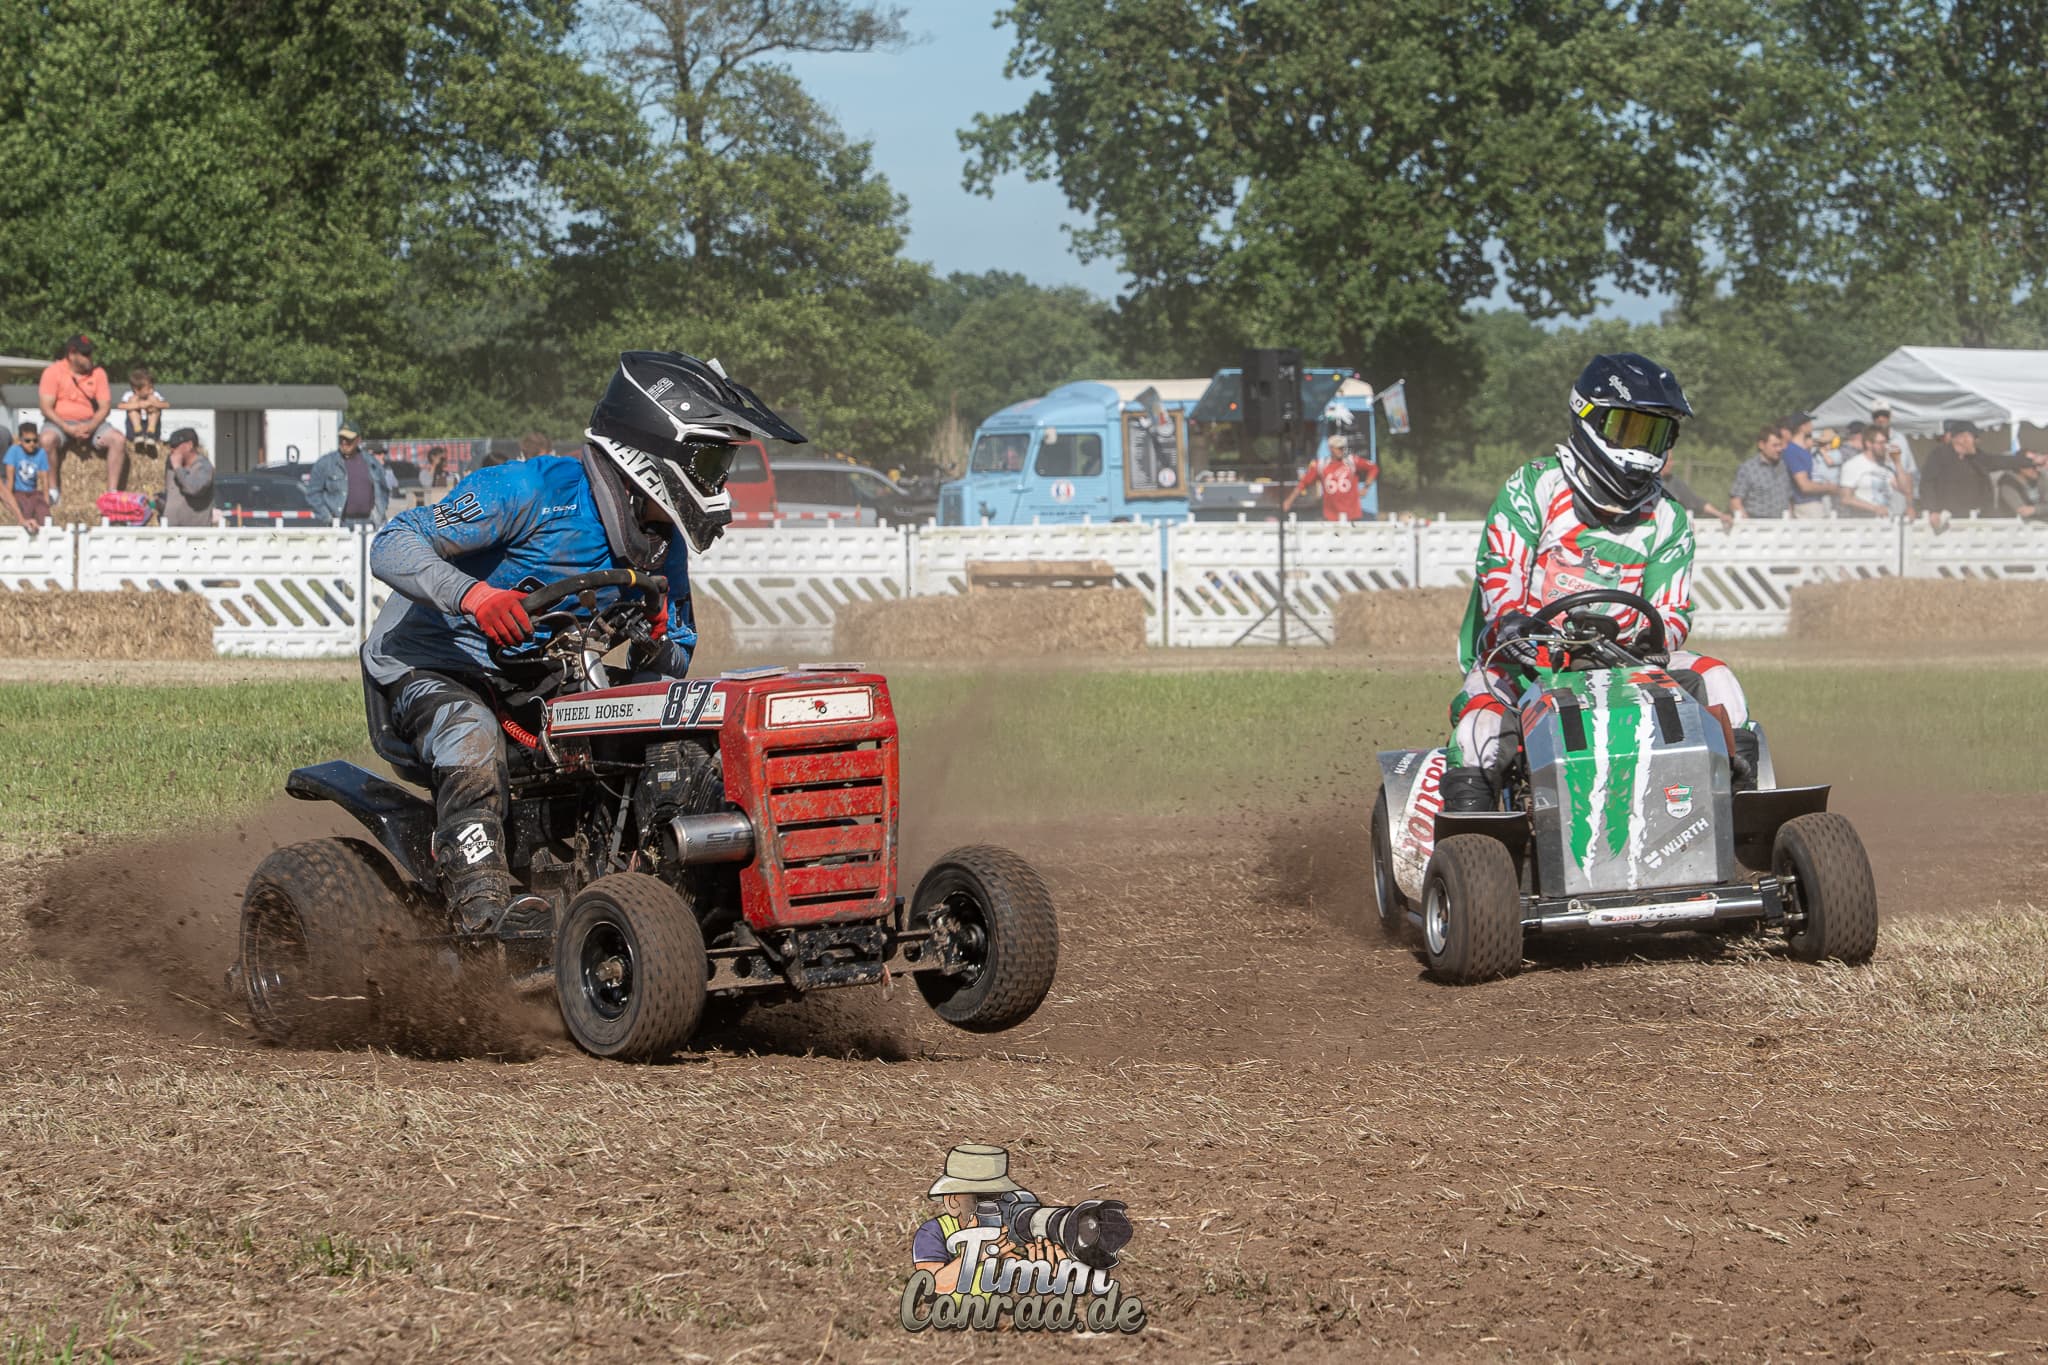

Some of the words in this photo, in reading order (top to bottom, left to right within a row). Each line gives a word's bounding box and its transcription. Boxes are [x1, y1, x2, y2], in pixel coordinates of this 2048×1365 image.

[1324, 470, 1352, 495] 66
[555, 705, 591, 722] WHEEL
[595, 703, 634, 719] HORSE
[660, 680, 719, 729] 87
